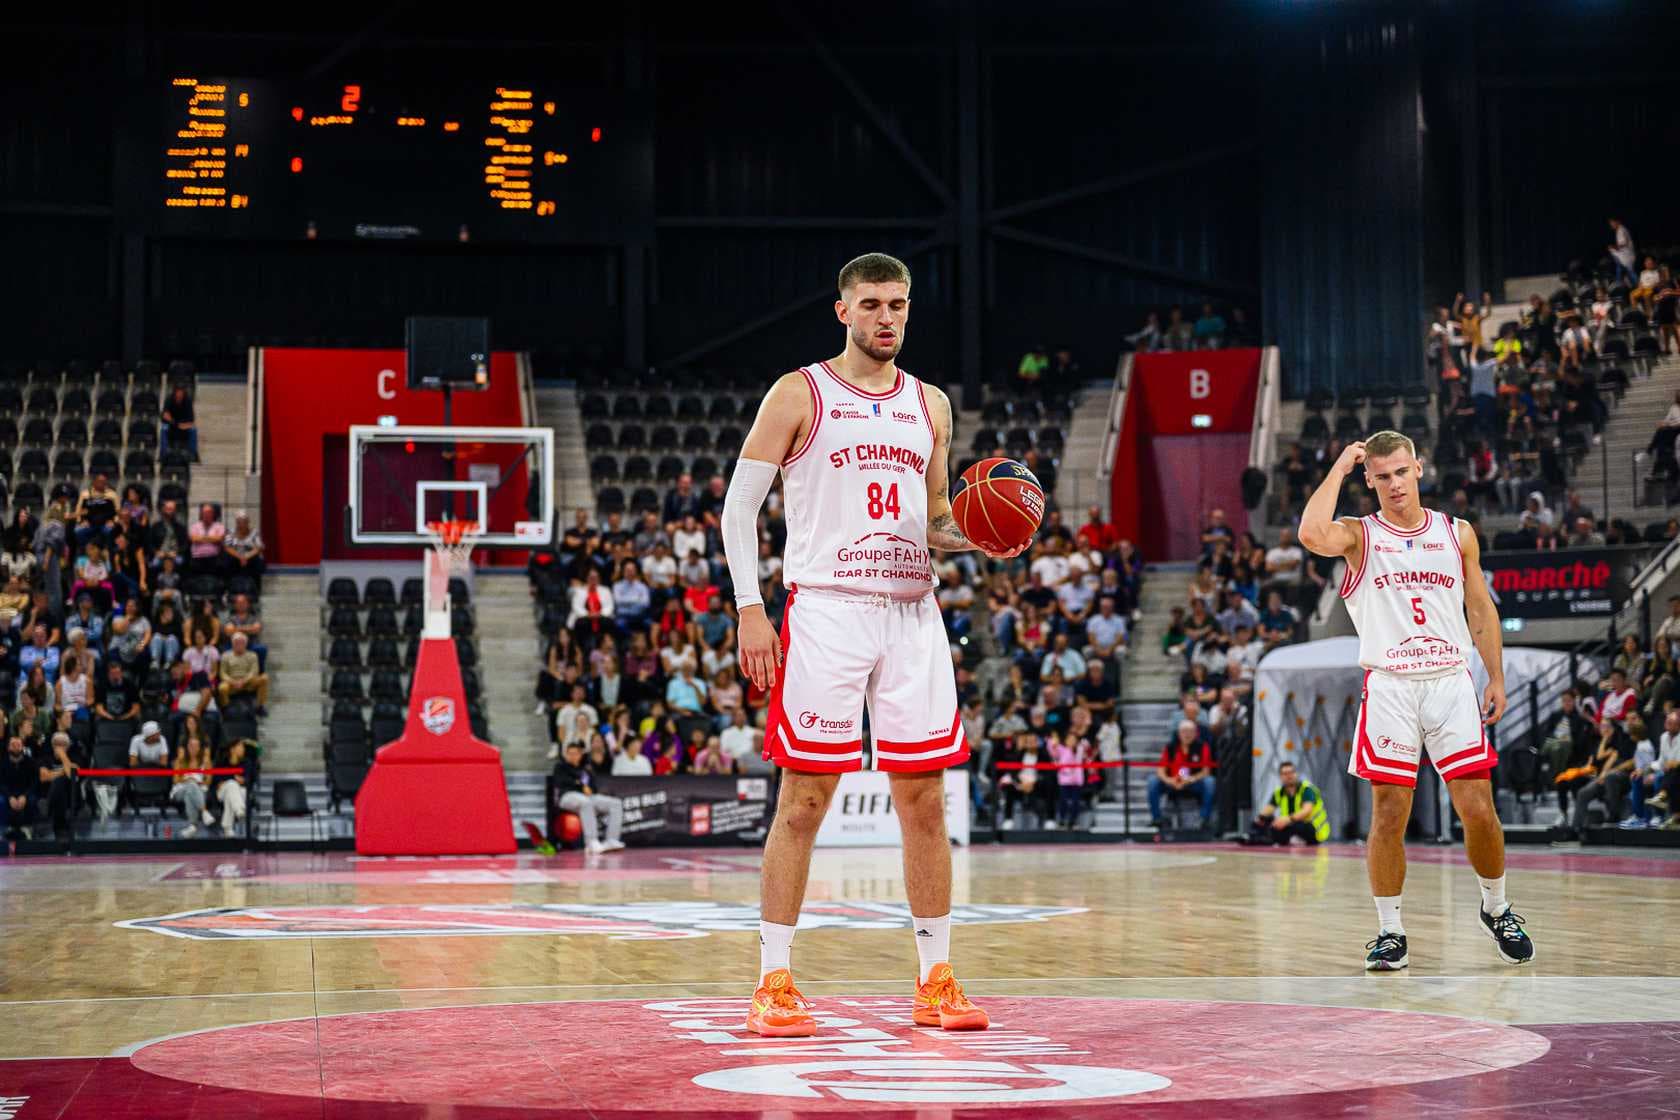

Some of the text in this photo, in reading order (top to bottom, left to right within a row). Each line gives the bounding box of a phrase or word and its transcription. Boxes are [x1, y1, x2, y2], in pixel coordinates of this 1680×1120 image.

[377, 369, 397, 400] C
[1189, 368, 1211, 399] B
[829, 448, 851, 469] ST
[866, 482, 901, 521] 84
[837, 547, 929, 564] Groupe FAHY
[833, 568, 931, 582] ICAR ST CHAMOND
[1374, 574, 1390, 590] ST
[1392, 571, 1455, 589] CHAMOND
[1411, 597, 1427, 626] 5
[842, 792, 953, 815] EIFE
